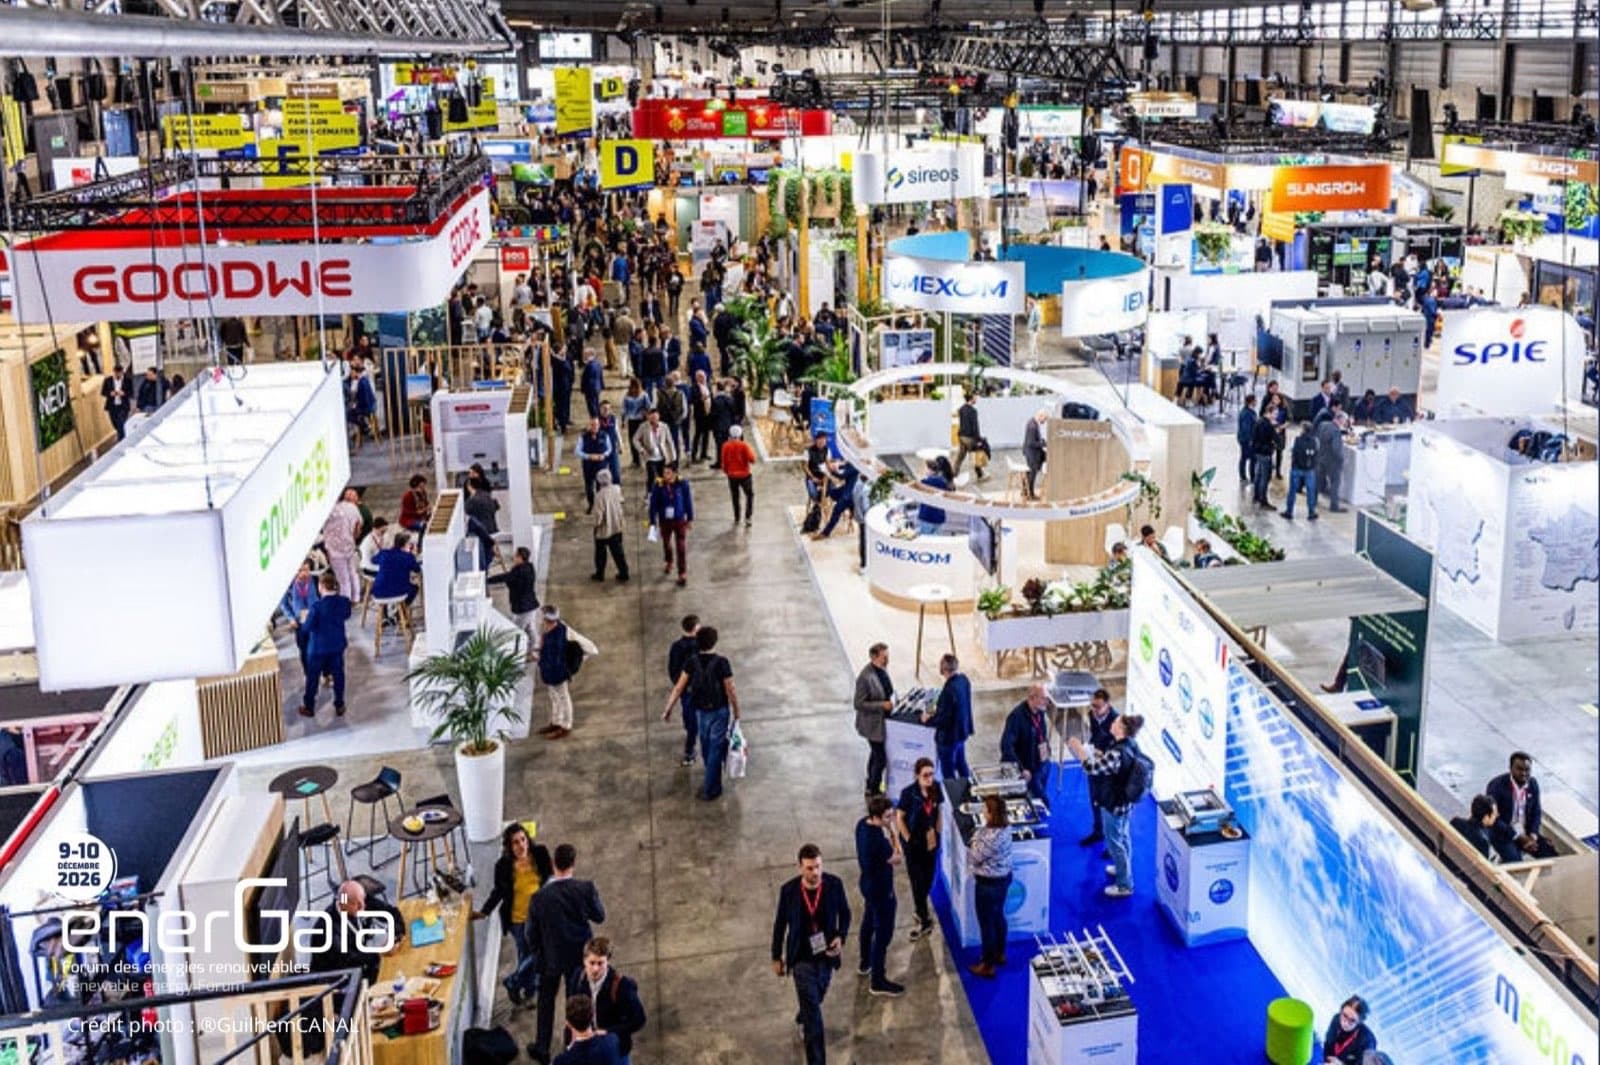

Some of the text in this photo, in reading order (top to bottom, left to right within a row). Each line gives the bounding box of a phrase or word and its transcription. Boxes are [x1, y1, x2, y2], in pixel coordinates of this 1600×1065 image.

[607, 80, 618, 93] D
[615, 145, 639, 176] D
[907, 165, 960, 184] sireos
[73, 260, 353, 305] GOODWE
[1452, 341, 1548, 365] SPIE
[875, 540, 952, 565] OMEXOM
